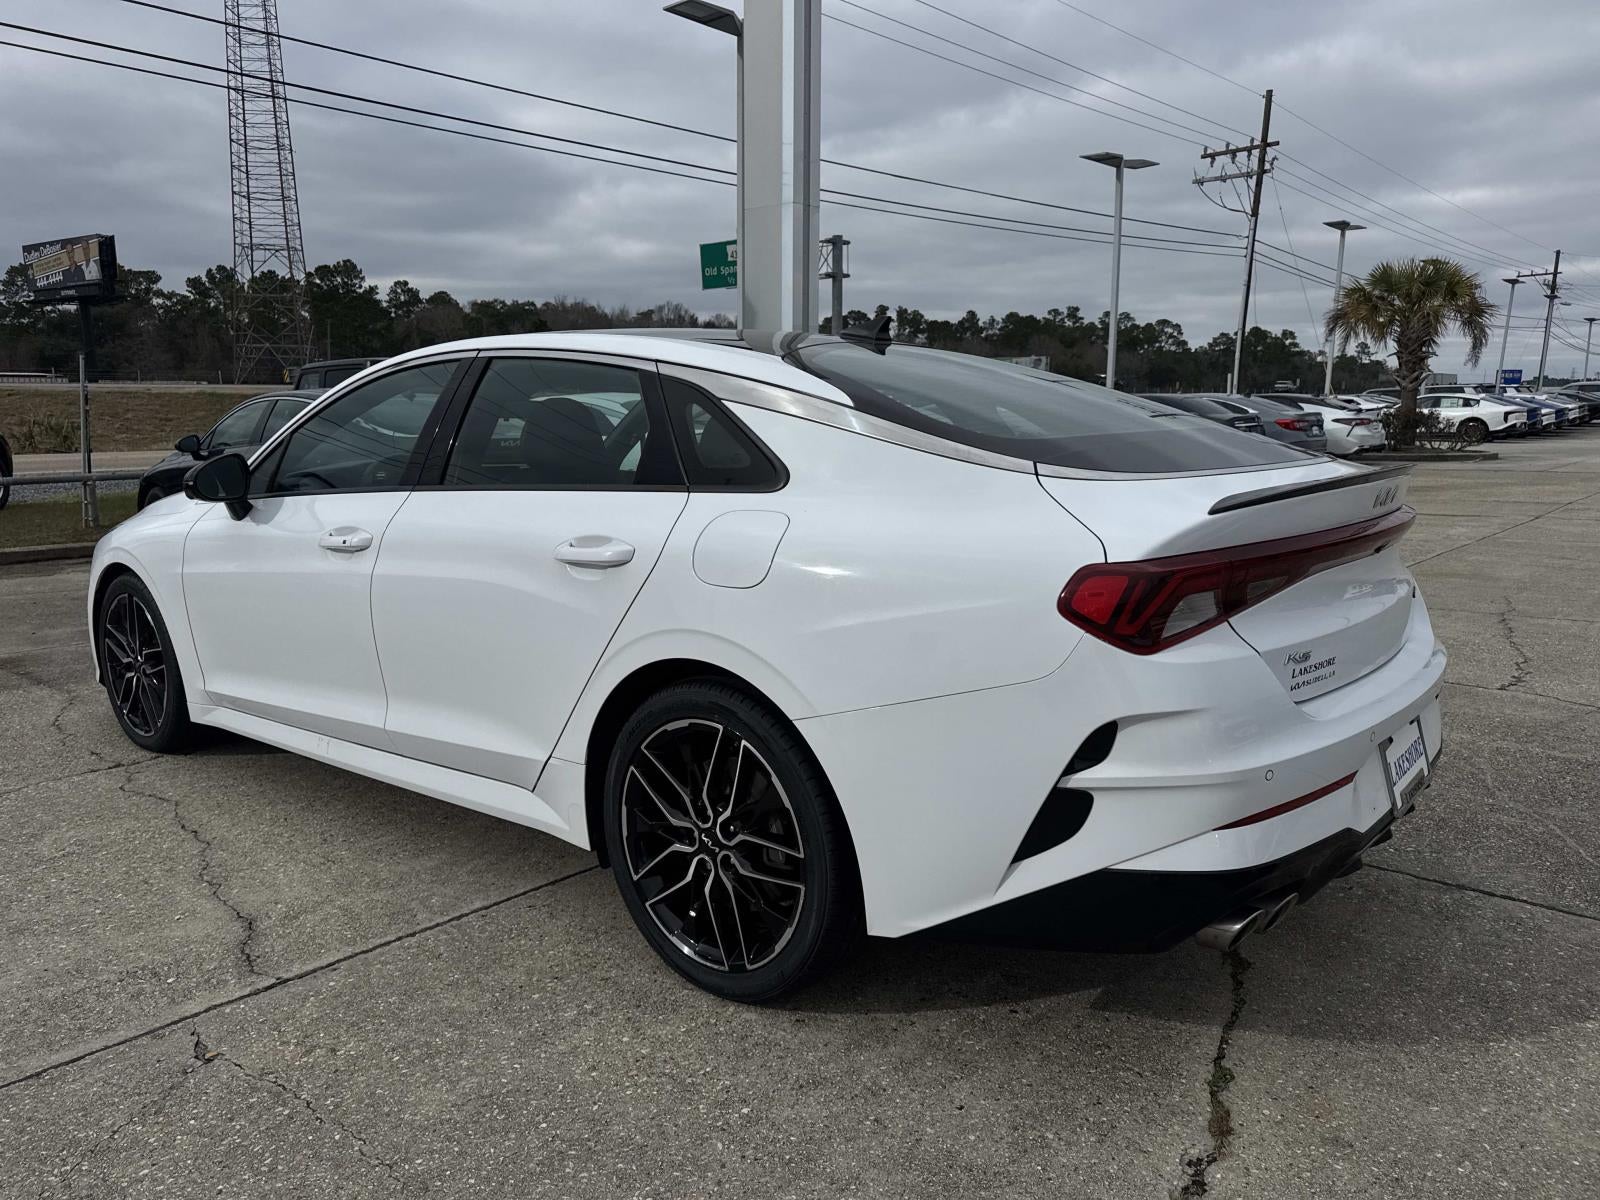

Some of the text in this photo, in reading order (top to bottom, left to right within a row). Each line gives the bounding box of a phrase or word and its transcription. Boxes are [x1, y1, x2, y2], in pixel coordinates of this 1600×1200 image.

[704, 266, 717, 276] Old
[1291, 656, 1336, 679] LAKESHORE
[1388, 736, 1424, 788] LAKESHORE
